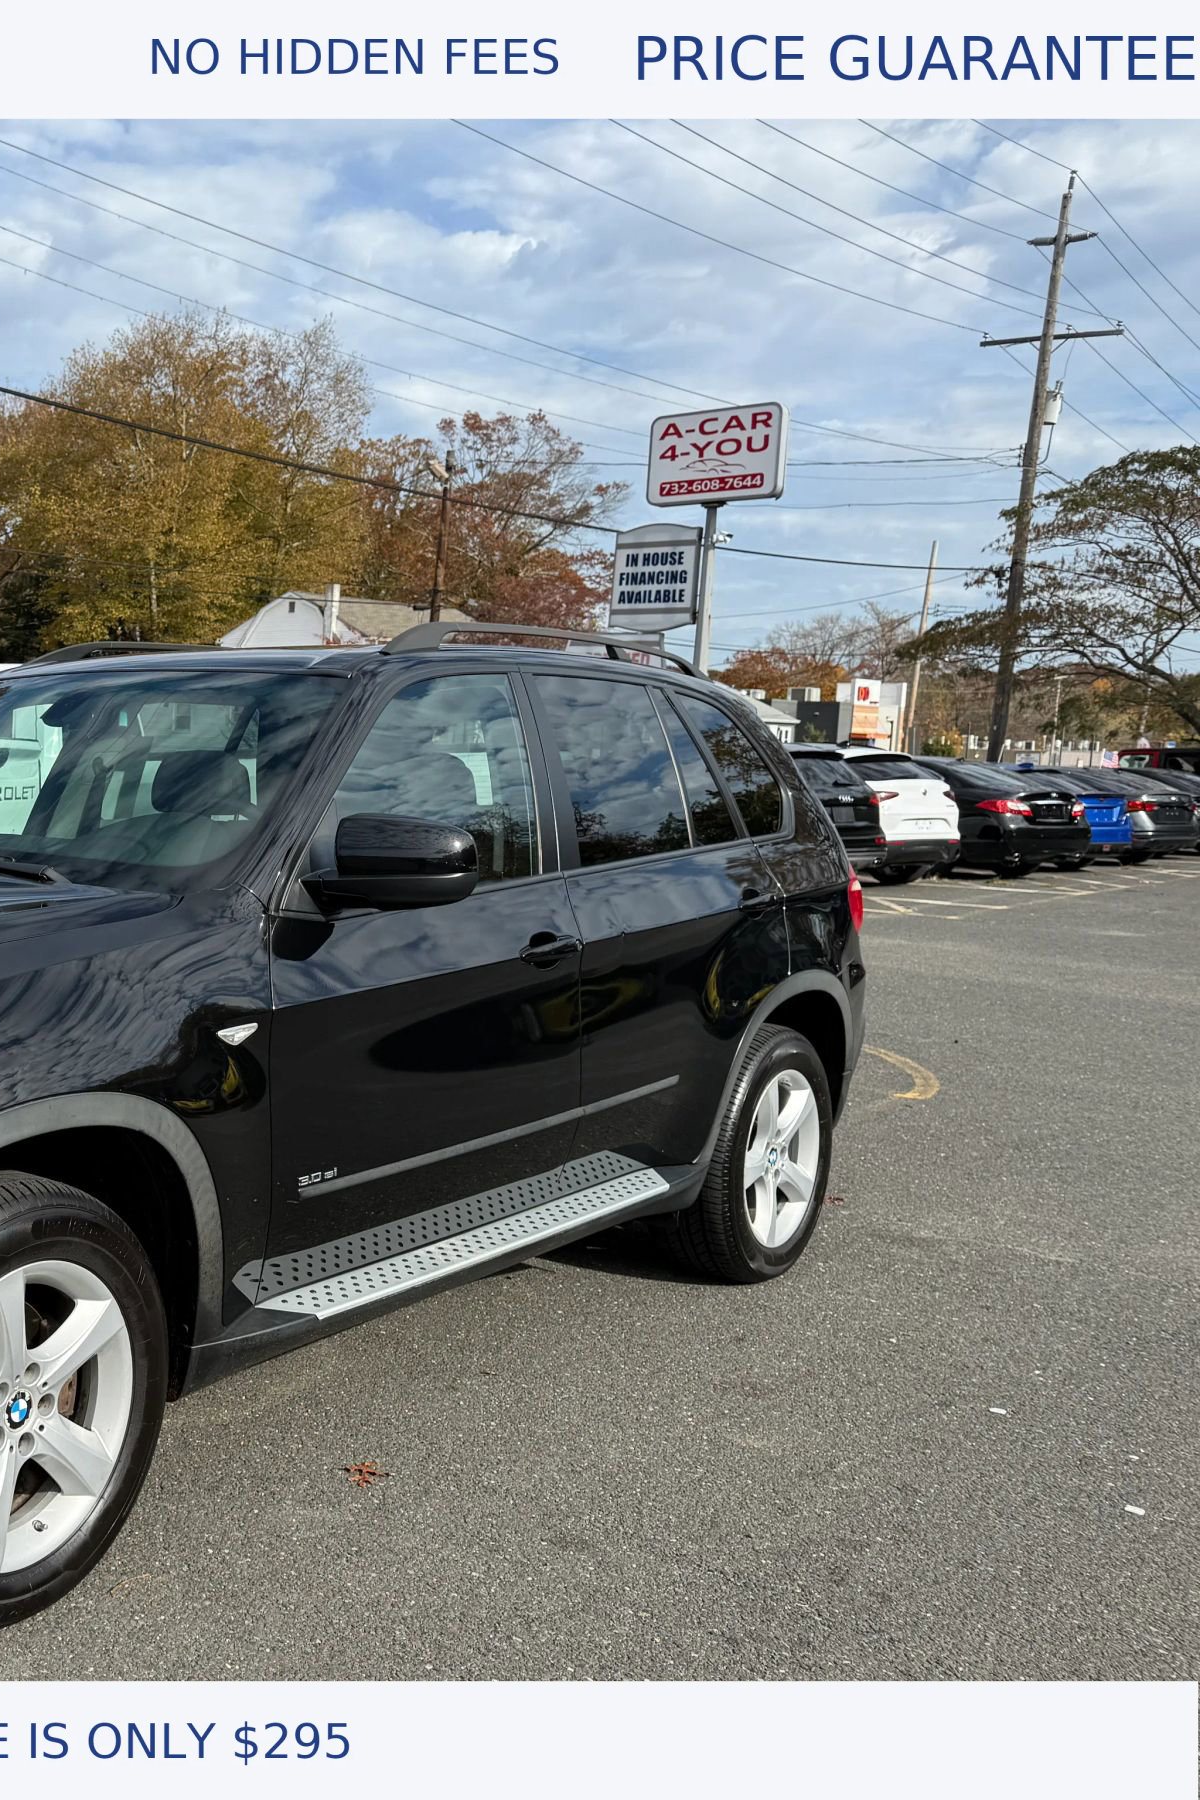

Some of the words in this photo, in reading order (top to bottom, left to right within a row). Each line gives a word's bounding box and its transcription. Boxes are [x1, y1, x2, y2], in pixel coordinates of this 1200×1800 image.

[658, 411, 773, 440] A-CAR
[658, 434, 770, 462] 4-YOU
[661, 474, 763, 495] 732-608-7644
[625, 553, 640, 568] IN
[642, 551, 685, 567] HOUSE
[618, 569, 688, 586] FINANCING
[617, 588, 685, 605] AVAILABLE
